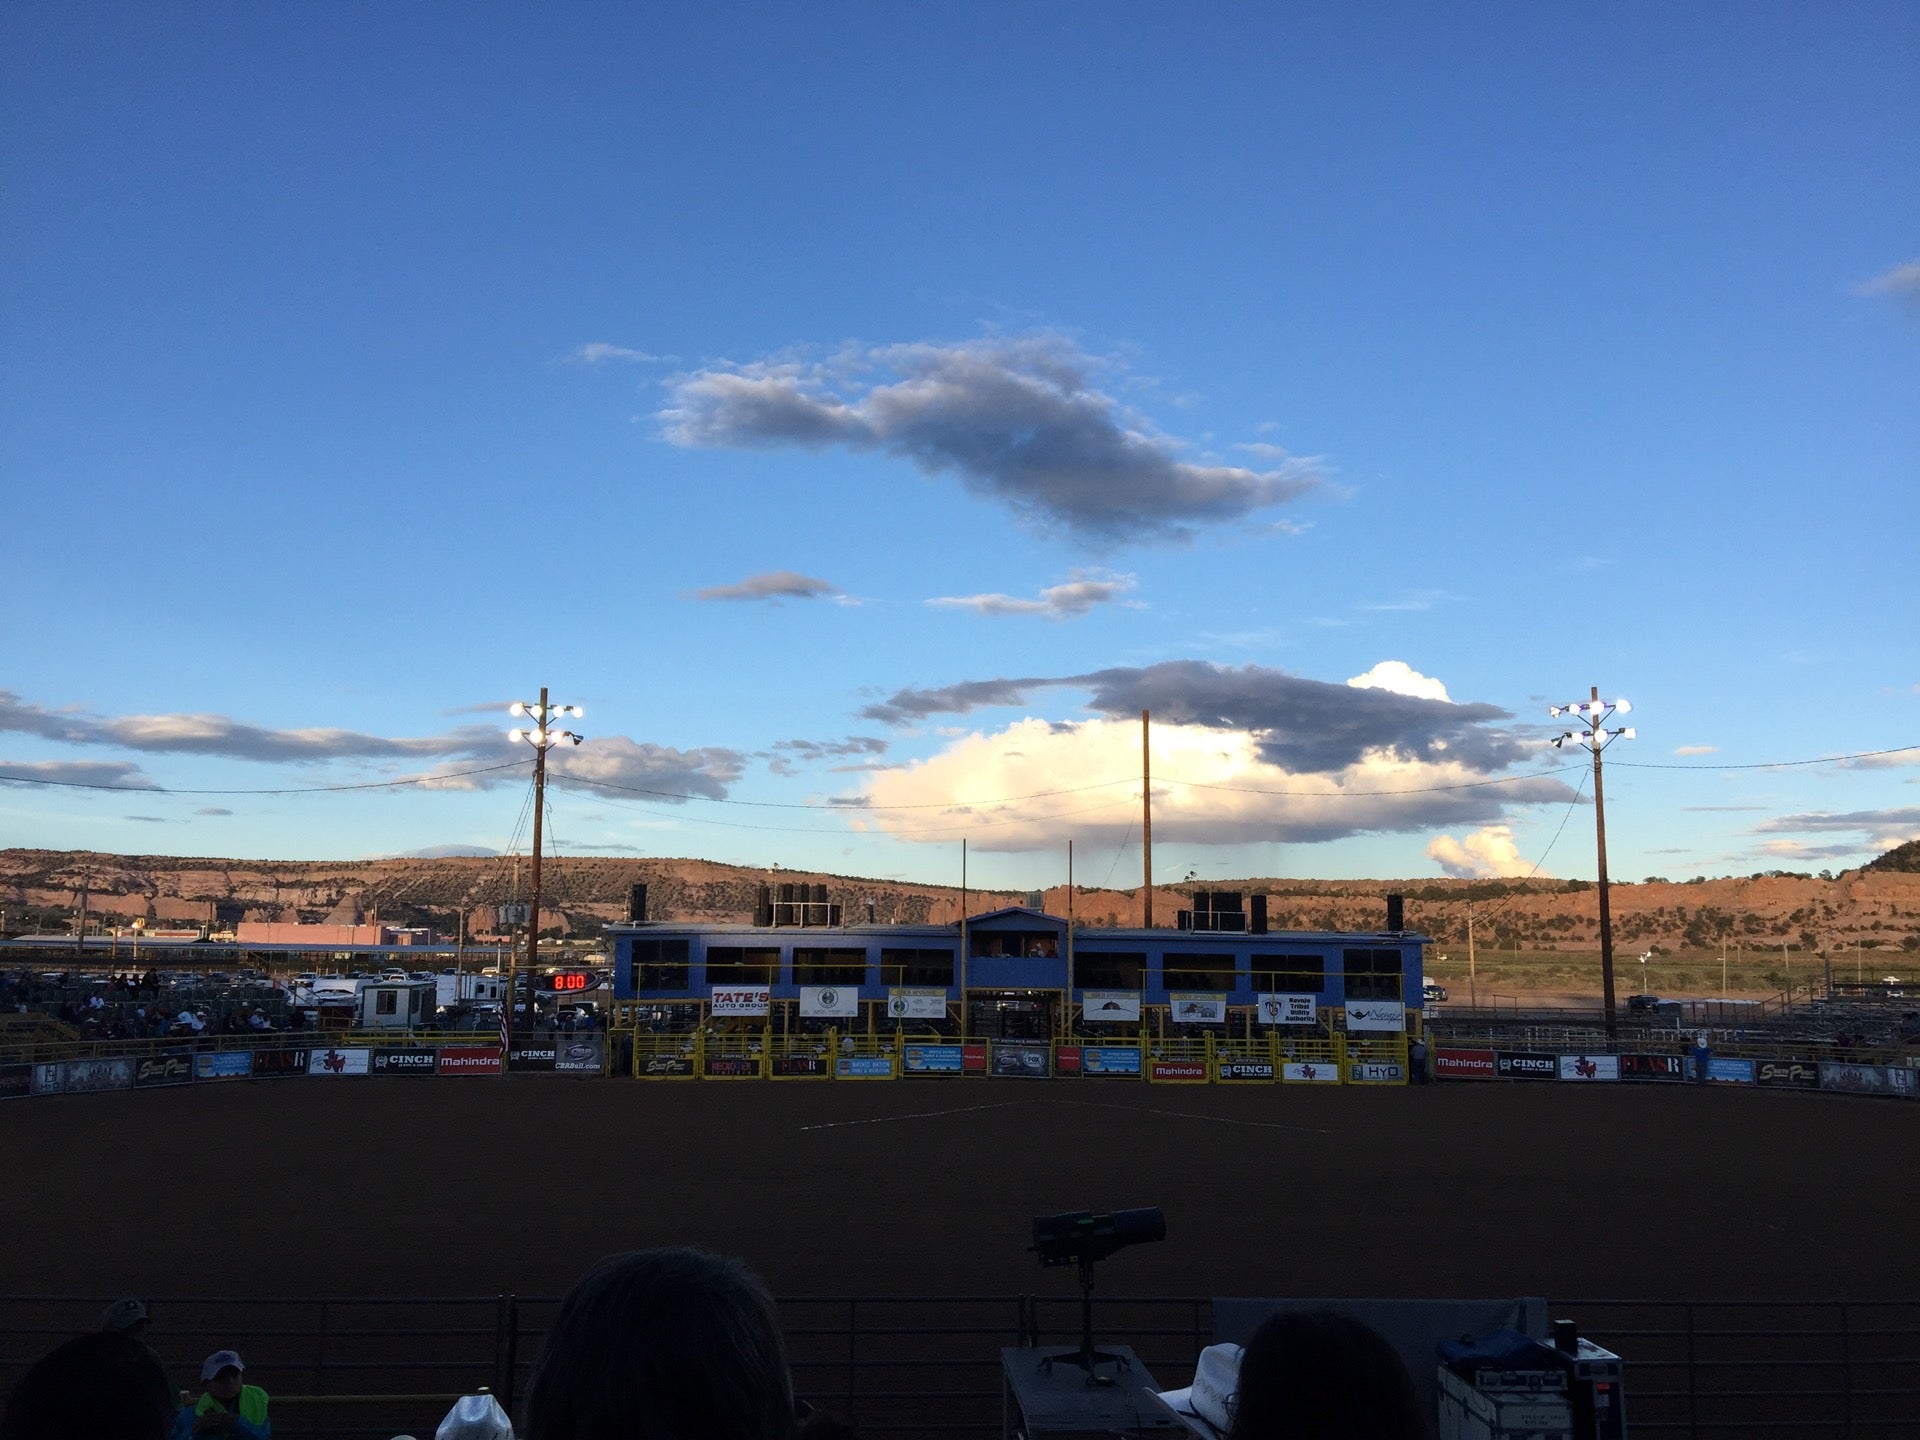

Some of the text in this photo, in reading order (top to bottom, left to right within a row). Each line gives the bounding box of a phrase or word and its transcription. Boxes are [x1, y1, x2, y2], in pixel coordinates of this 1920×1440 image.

[713, 992, 769, 1003] TATE'S
[389, 1055, 434, 1064] CINCH
[441, 1057, 500, 1066] Mahindra
[1437, 1057, 1494, 1068] Mahindra
[1512, 1058, 1555, 1068] CINCH
[1156, 1067, 1203, 1075] Mahindra
[1232, 1065, 1273, 1073] CINCH
